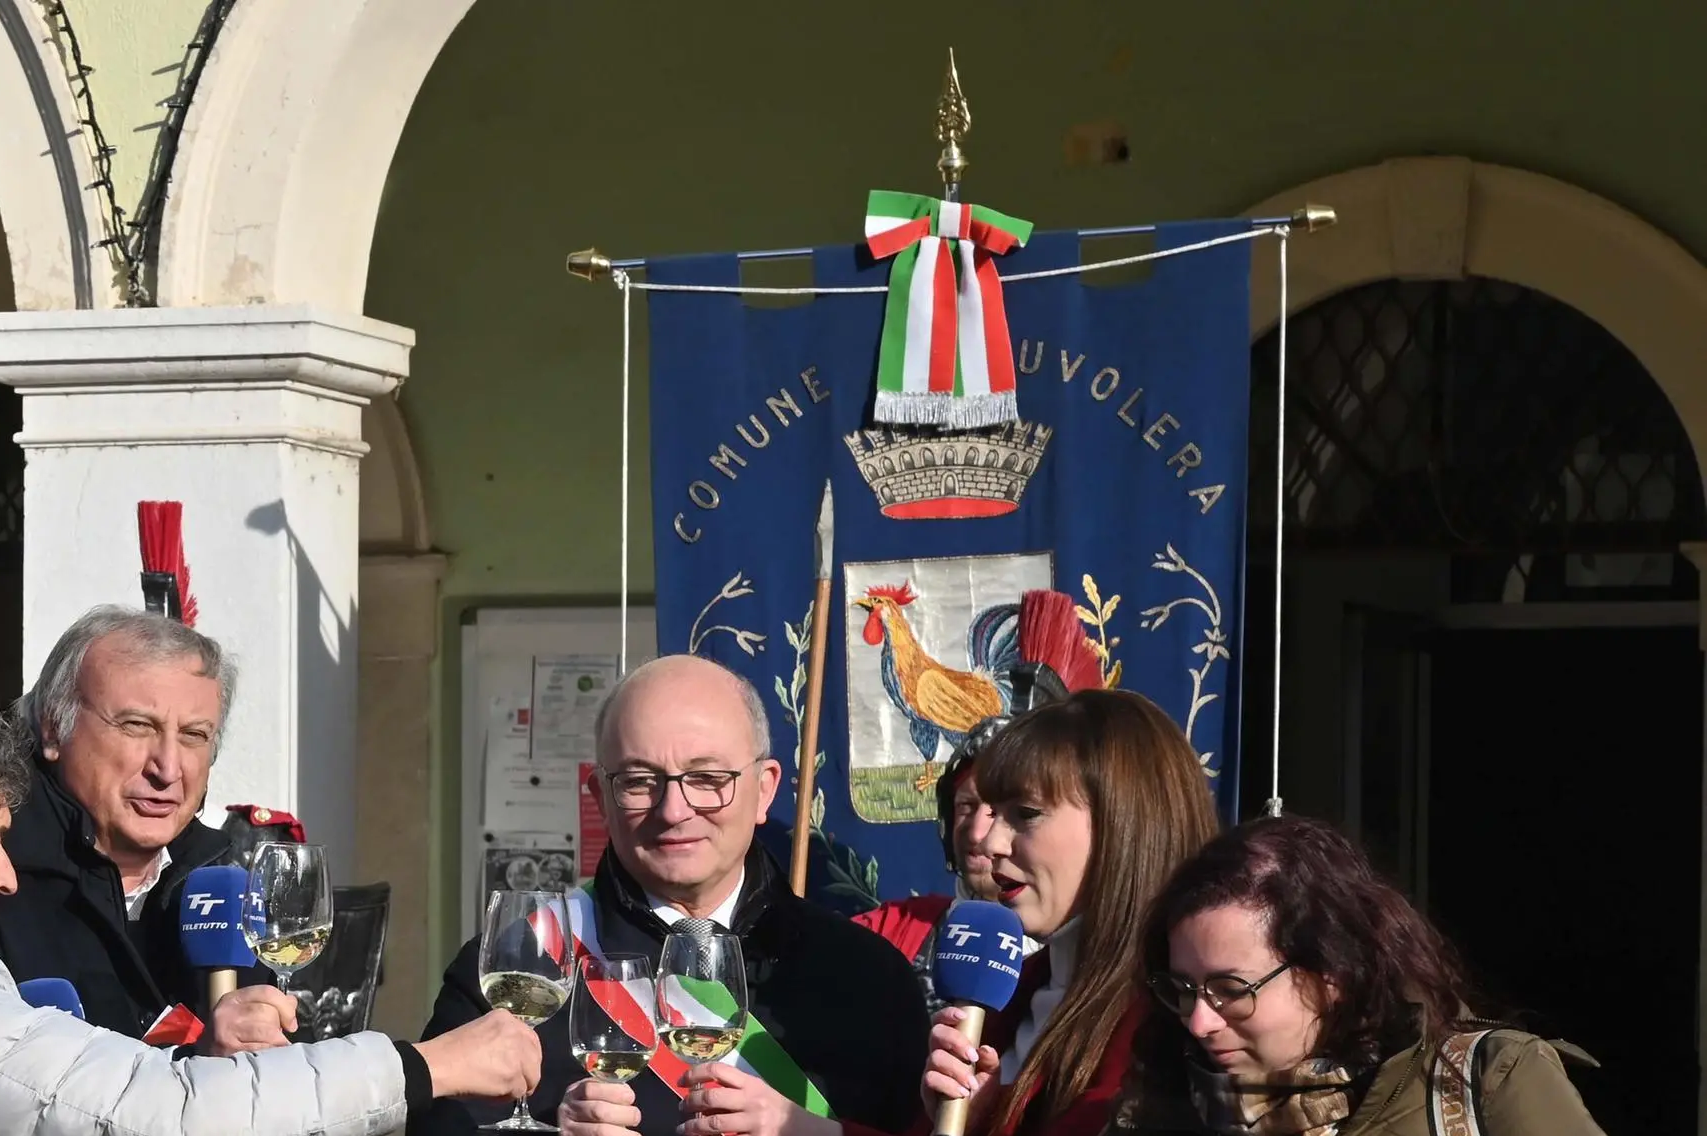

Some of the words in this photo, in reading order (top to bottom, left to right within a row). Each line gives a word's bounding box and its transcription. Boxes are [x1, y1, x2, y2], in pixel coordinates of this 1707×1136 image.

[673, 366, 831, 544] COMUNE
[1018, 339, 1226, 514] UVOLERA
[187, 893, 225, 916] TT
[182, 921, 228, 932] TELETUTTO
[947, 923, 981, 947] TT
[935, 952, 980, 963] TELETUTTO
[997, 932, 1022, 961] TT
